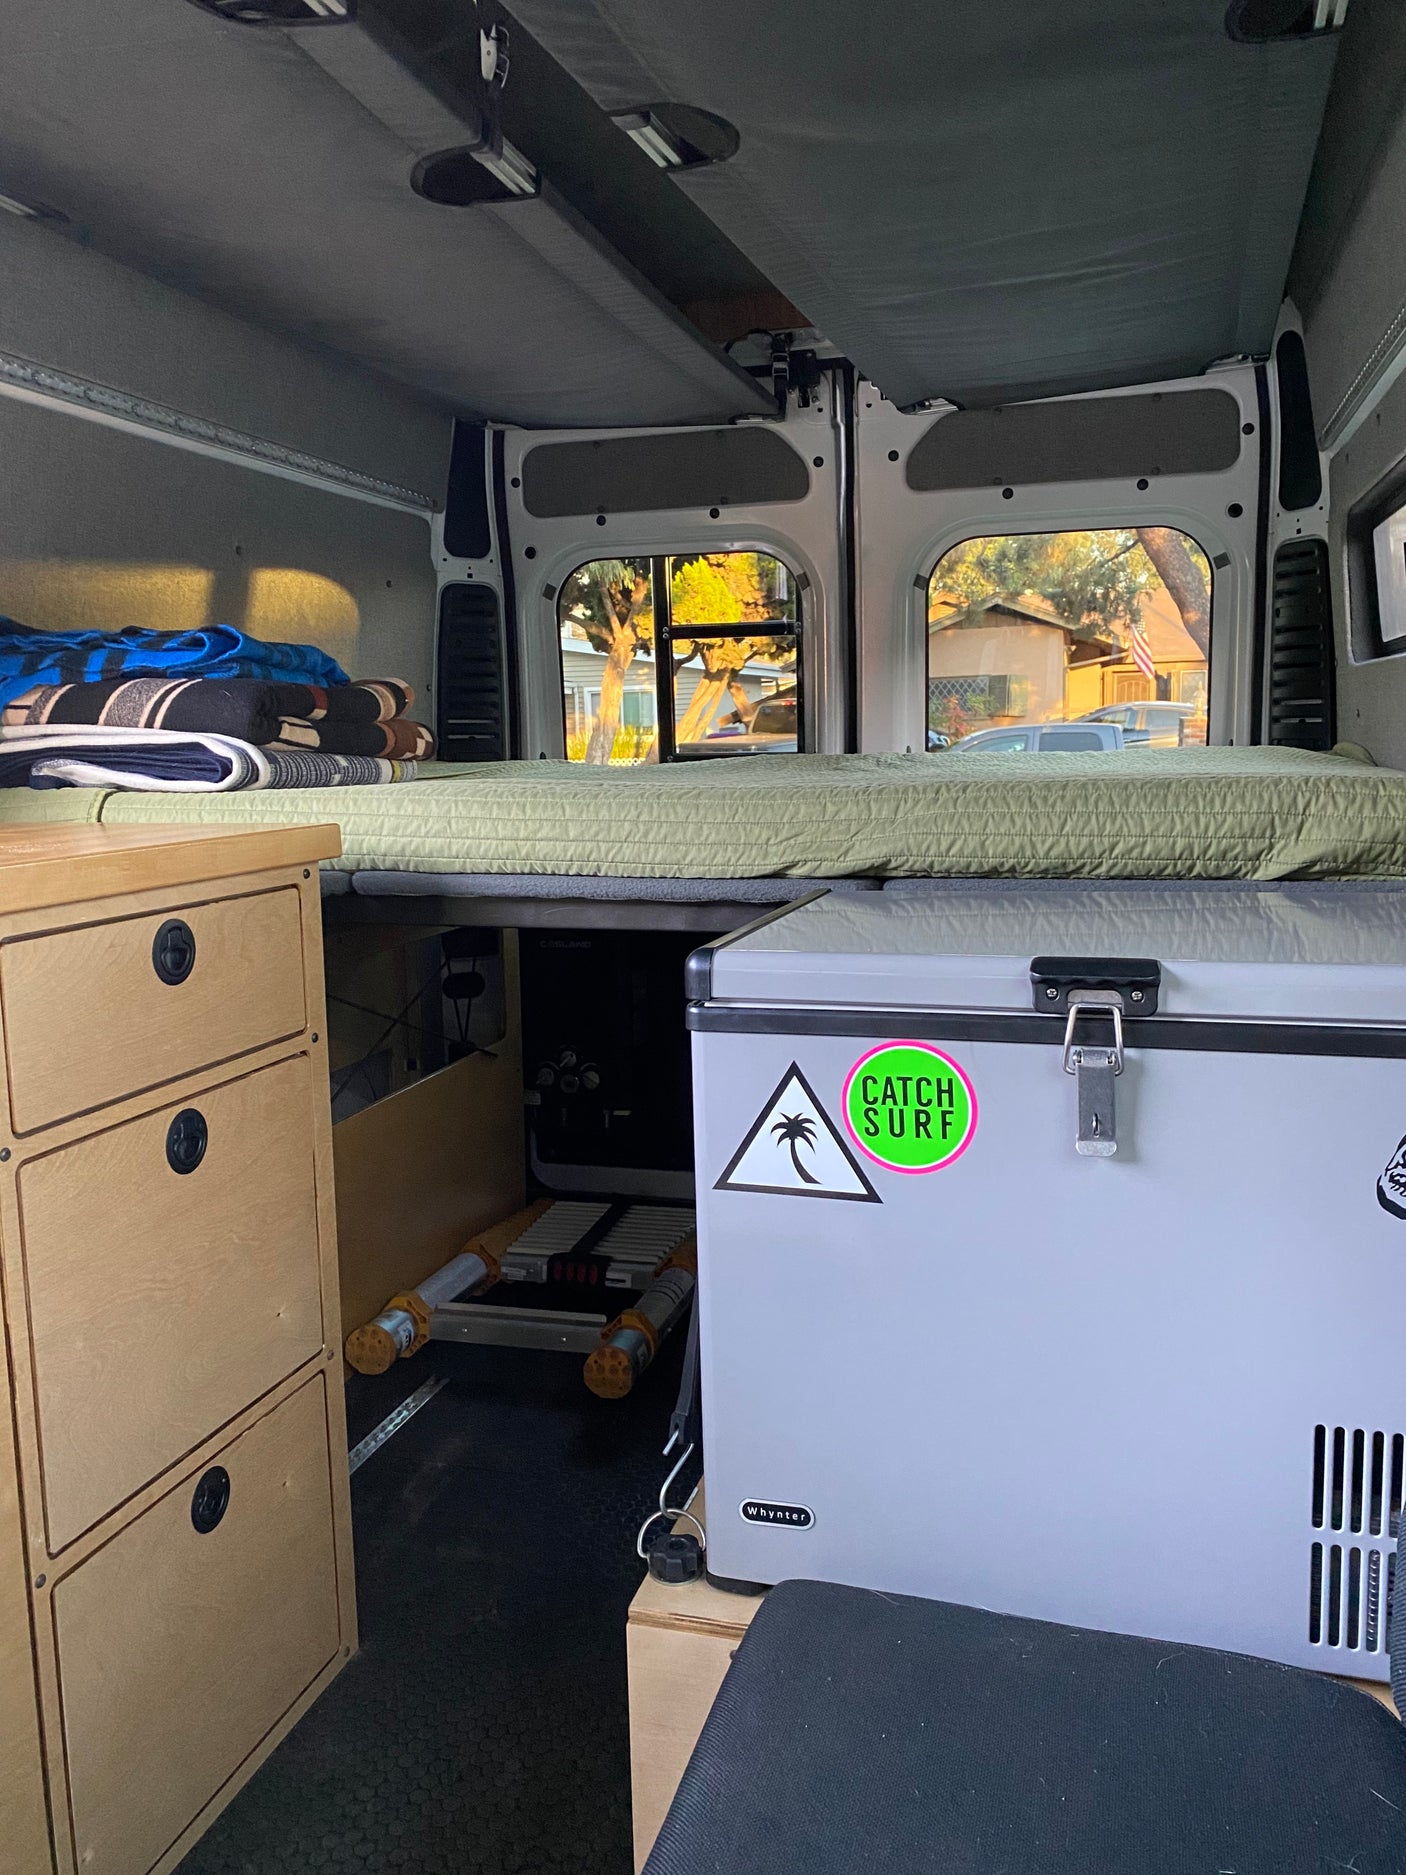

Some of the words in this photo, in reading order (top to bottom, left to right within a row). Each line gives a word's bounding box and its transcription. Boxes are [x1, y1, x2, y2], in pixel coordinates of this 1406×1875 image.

[861, 1075, 954, 1108] CATCH
[863, 1106, 955, 1140] SURF
[746, 1506, 806, 1521] Whynter
